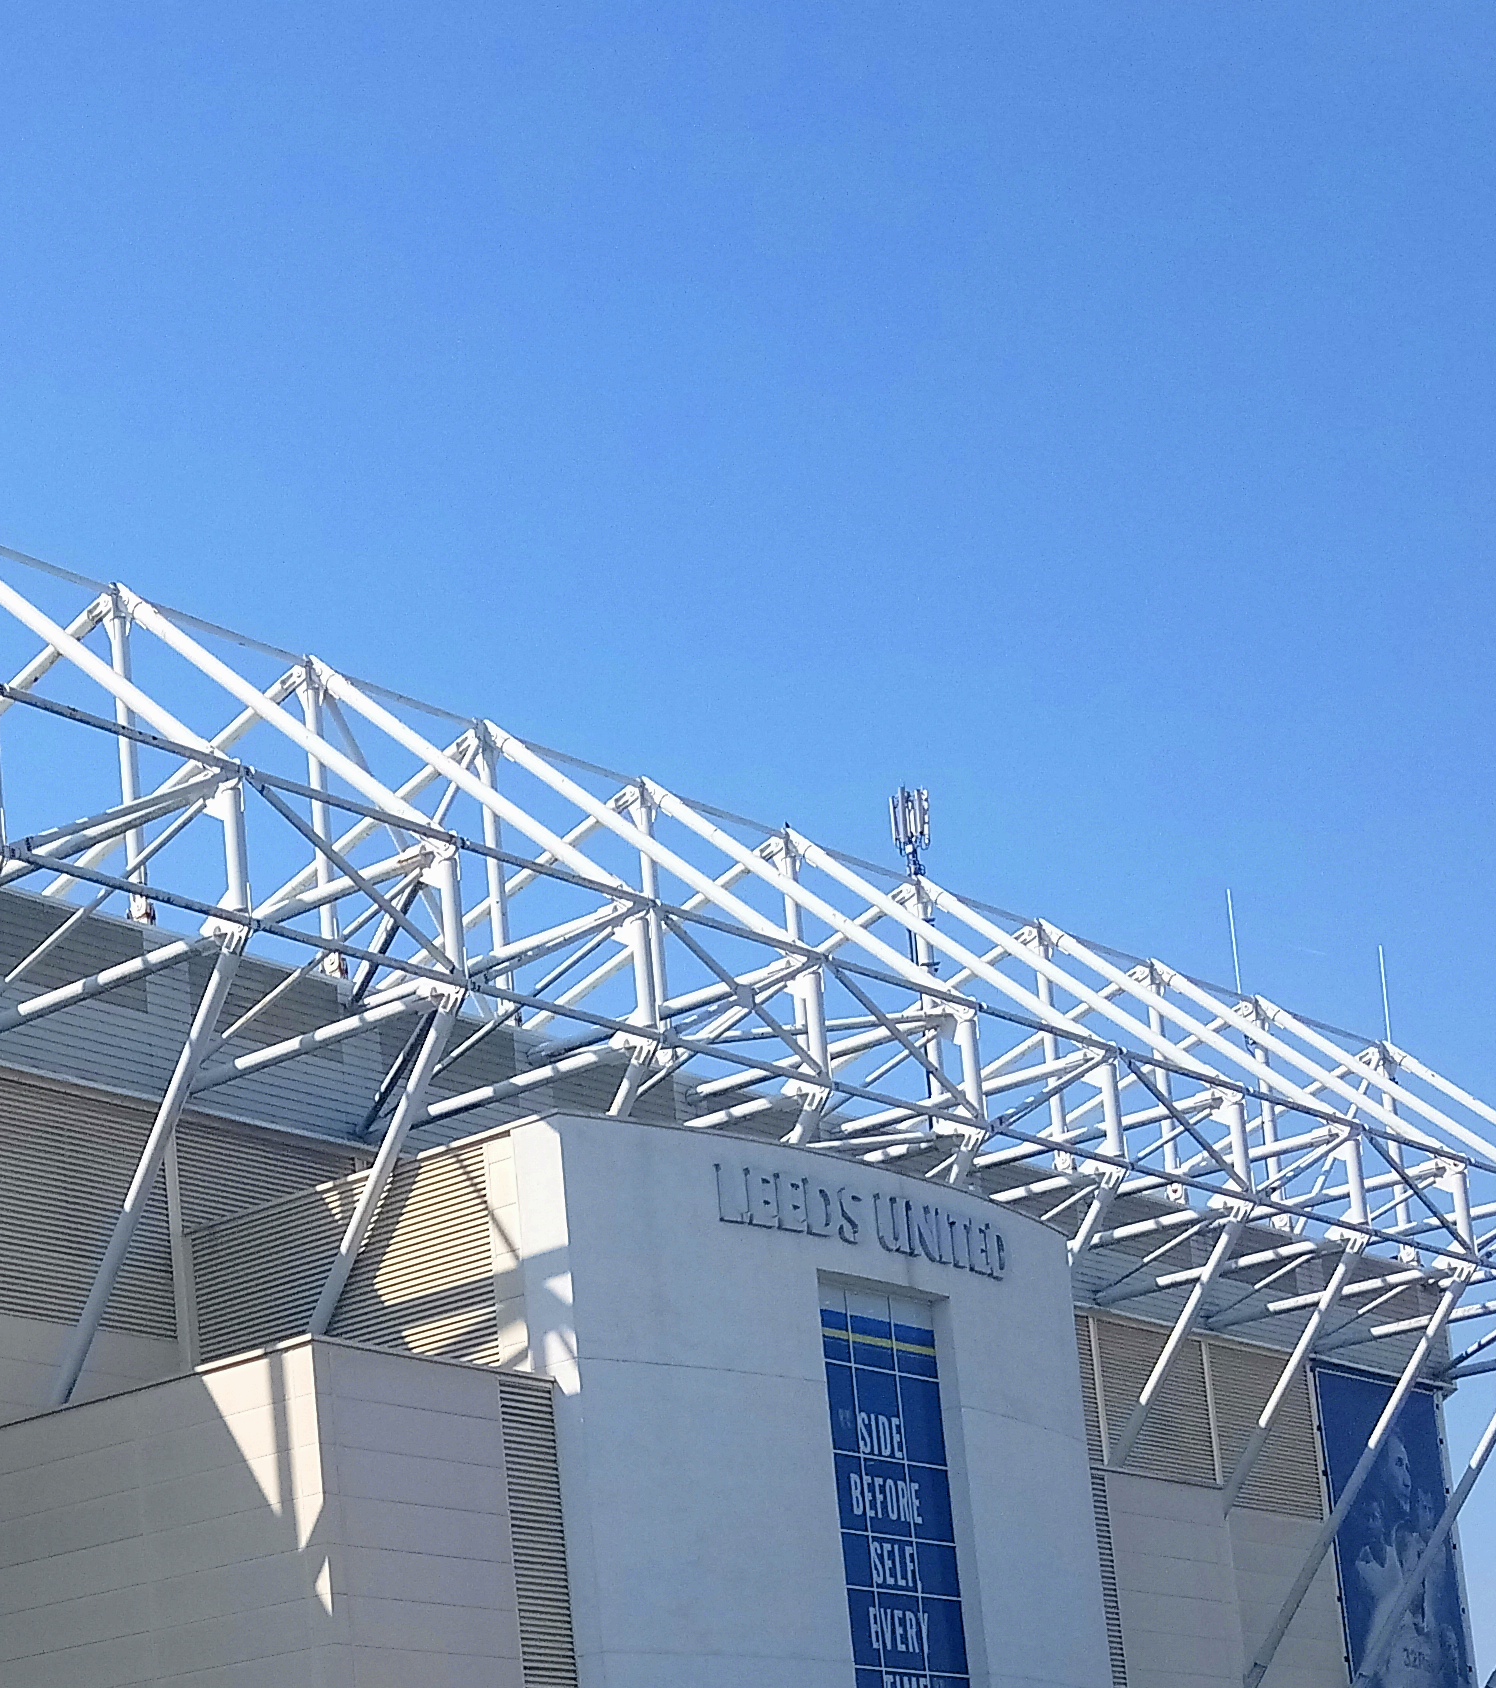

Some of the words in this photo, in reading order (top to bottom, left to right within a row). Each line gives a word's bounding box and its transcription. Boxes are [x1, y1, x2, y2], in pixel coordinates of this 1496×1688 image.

[713, 1163, 861, 1245] LEEDS
[873, 1192, 1006, 1282] UNITED
[850, 1472, 923, 1525] BEFORE
[869, 1606, 929, 1654] EVERY
